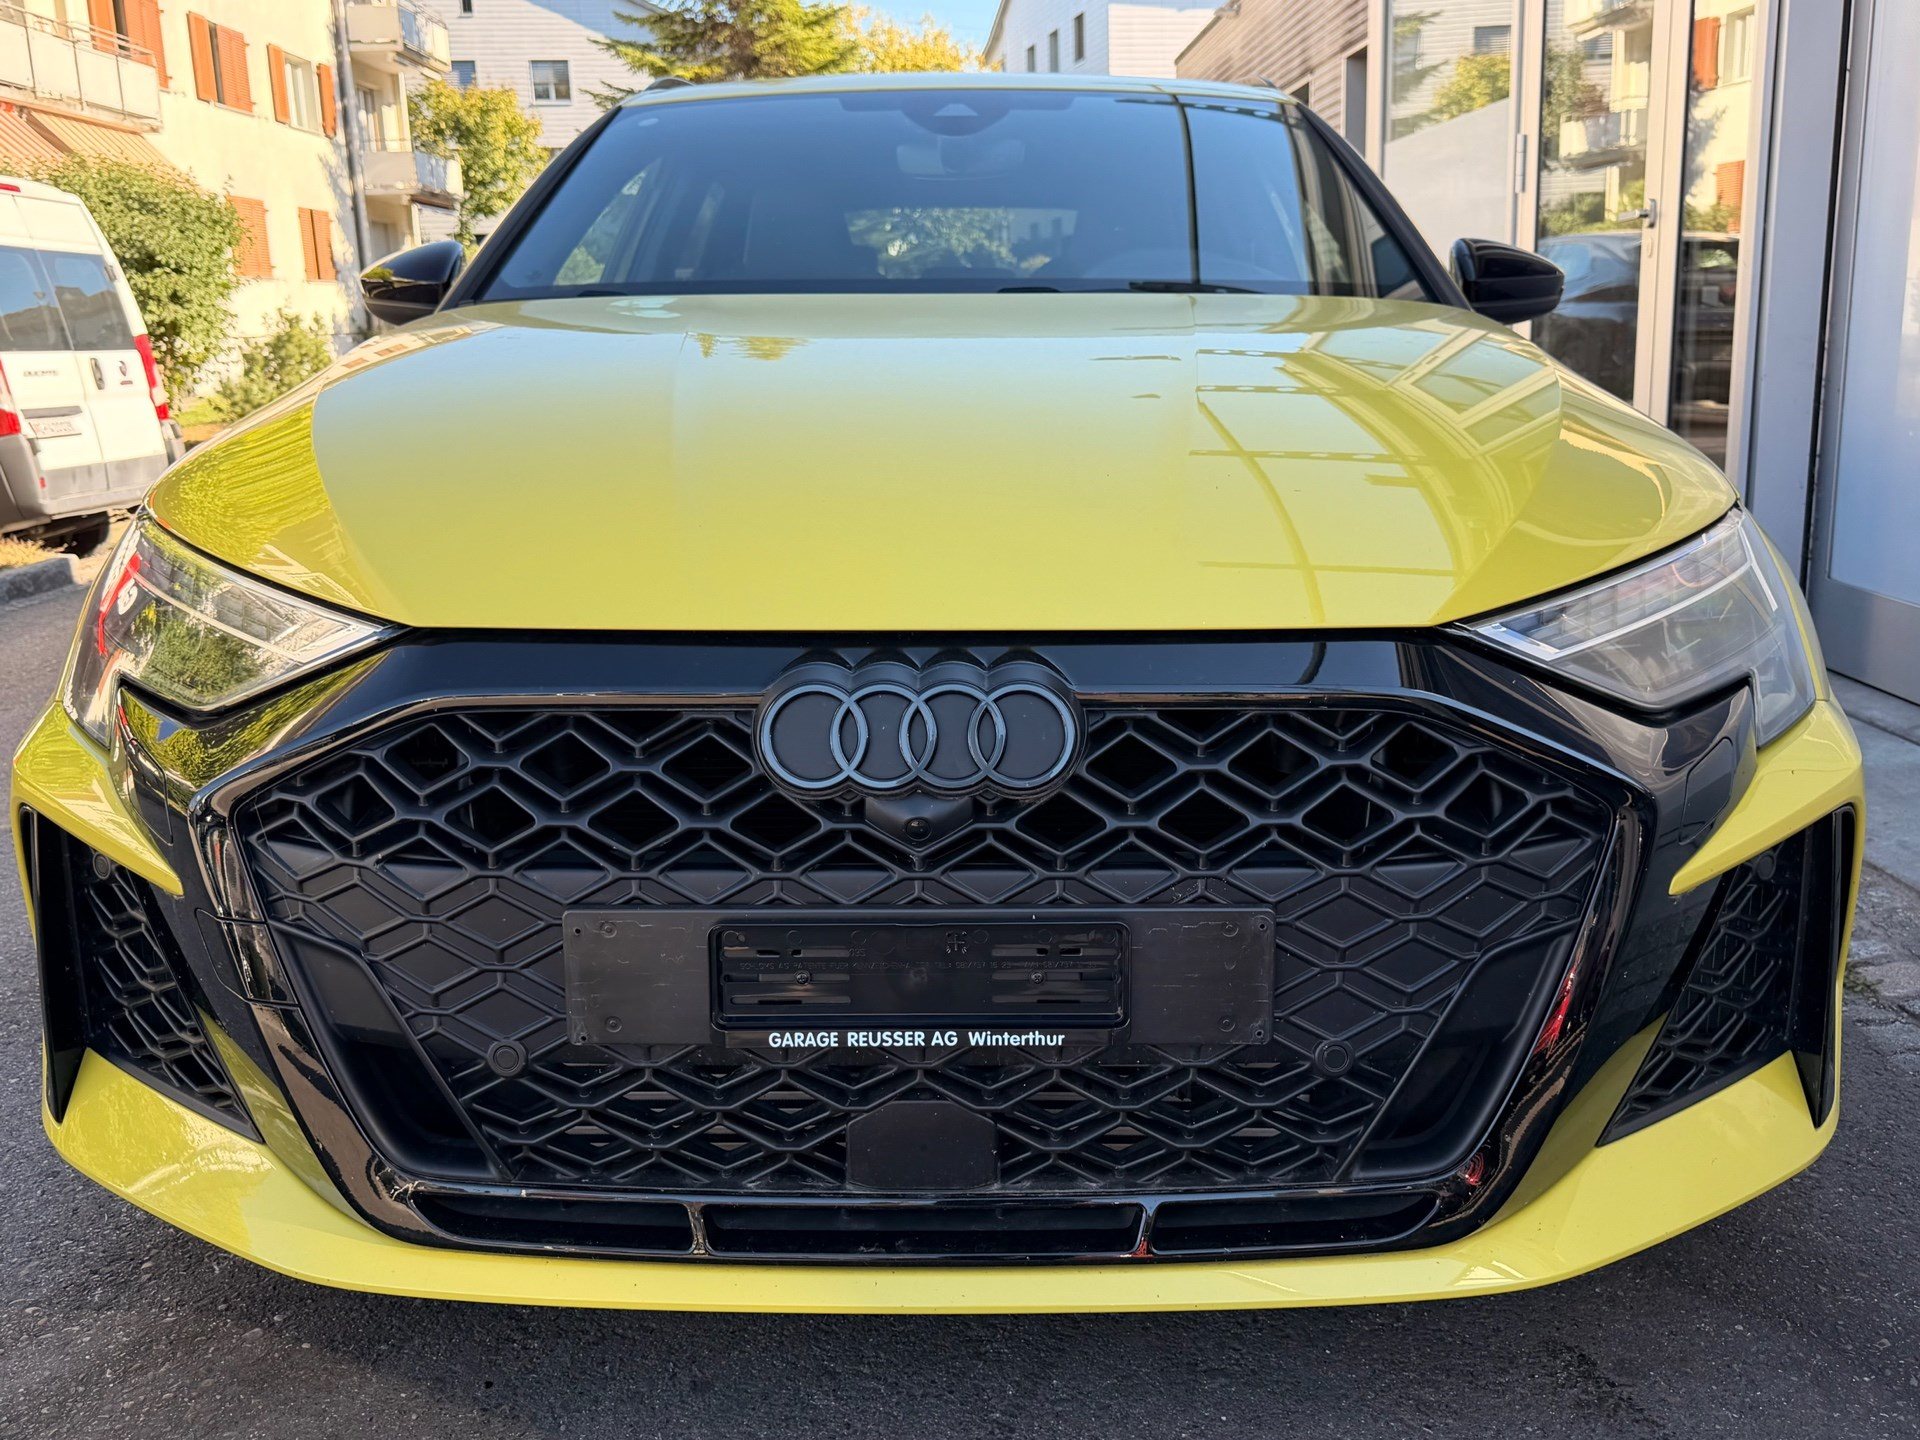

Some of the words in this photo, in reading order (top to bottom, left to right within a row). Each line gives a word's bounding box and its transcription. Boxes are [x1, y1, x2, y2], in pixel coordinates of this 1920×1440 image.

[768, 1031, 839, 1048] GARAGE
[847, 1031, 926, 1047] REUSSER
[930, 1031, 958, 1047] AG
[968, 1030, 1066, 1047] Winterthur
